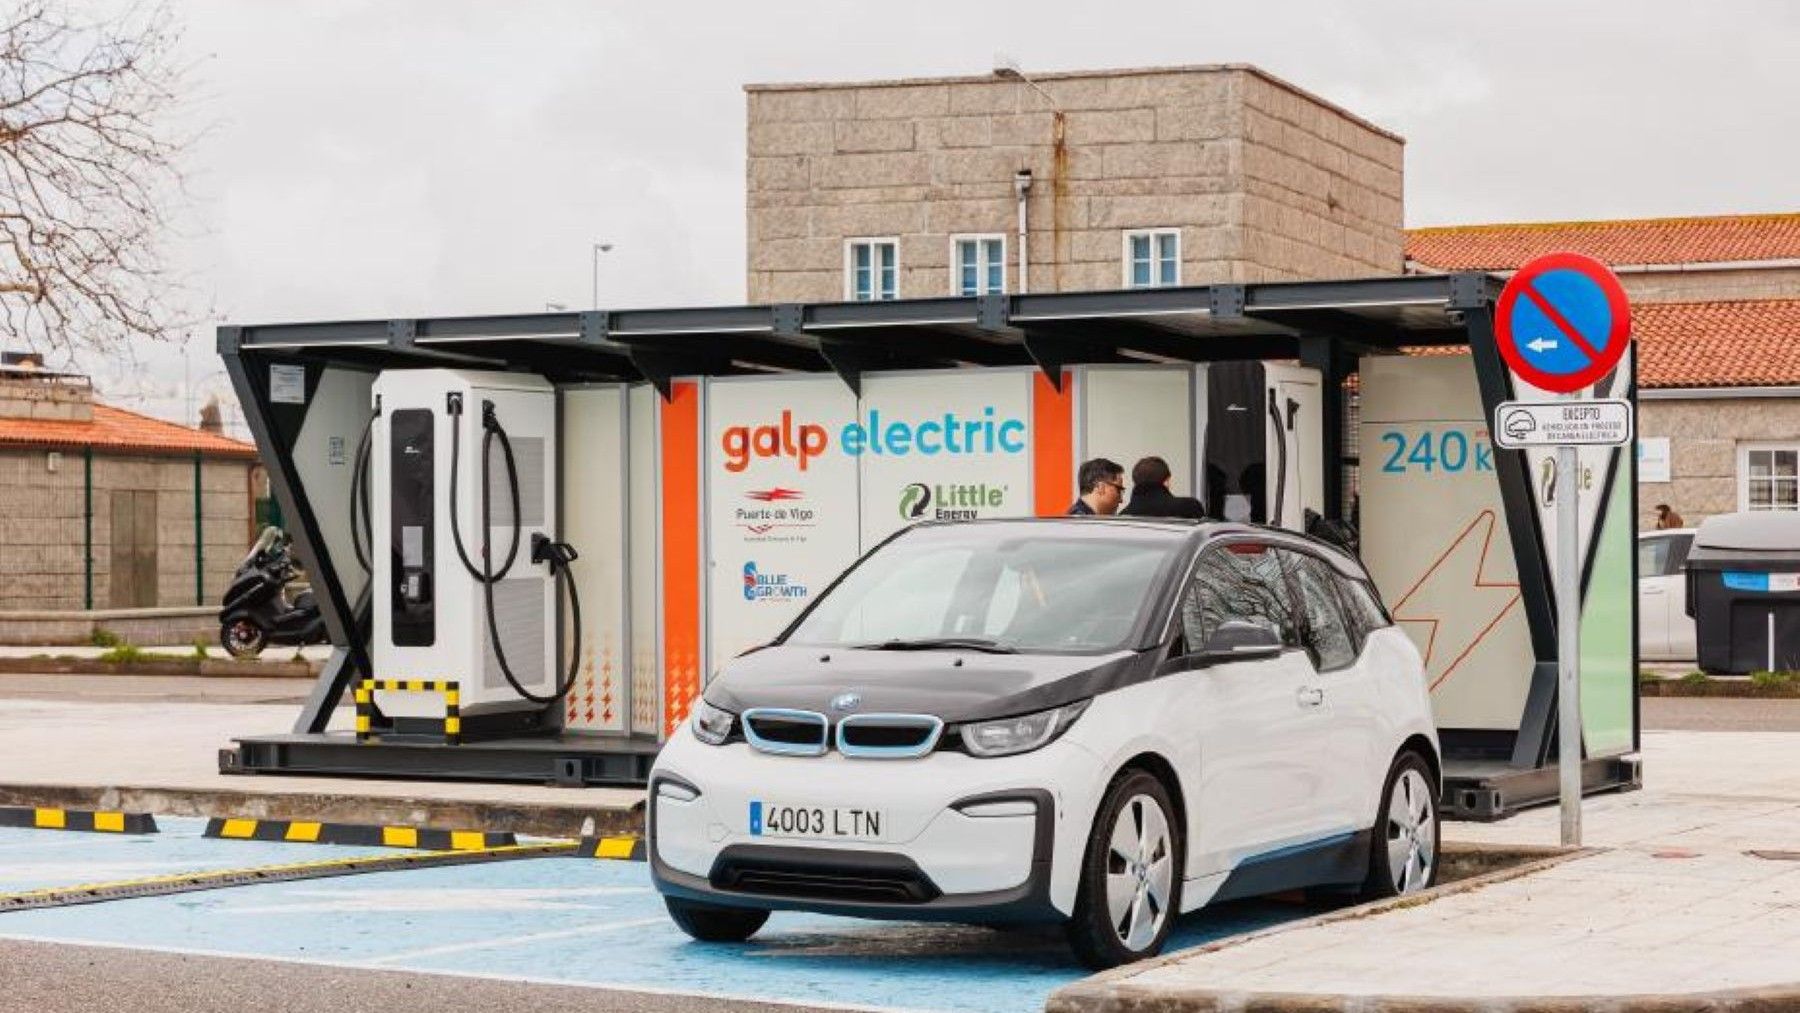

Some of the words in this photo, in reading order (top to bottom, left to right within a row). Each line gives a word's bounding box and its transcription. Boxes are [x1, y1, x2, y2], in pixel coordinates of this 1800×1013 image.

[722, 409, 828, 472] galp
[841, 406, 1025, 455] electric
[1382, 430, 1468, 473] 240
[1476, 443, 1494, 471] k
[935, 484, 1003, 506] Little
[790, 507, 813, 520] Vigo
[757, 574, 787, 585] BLUE
[756, 586, 807, 597] GROWTH
[767, 807, 825, 833] 4003
[834, 809, 880, 836] LTN
